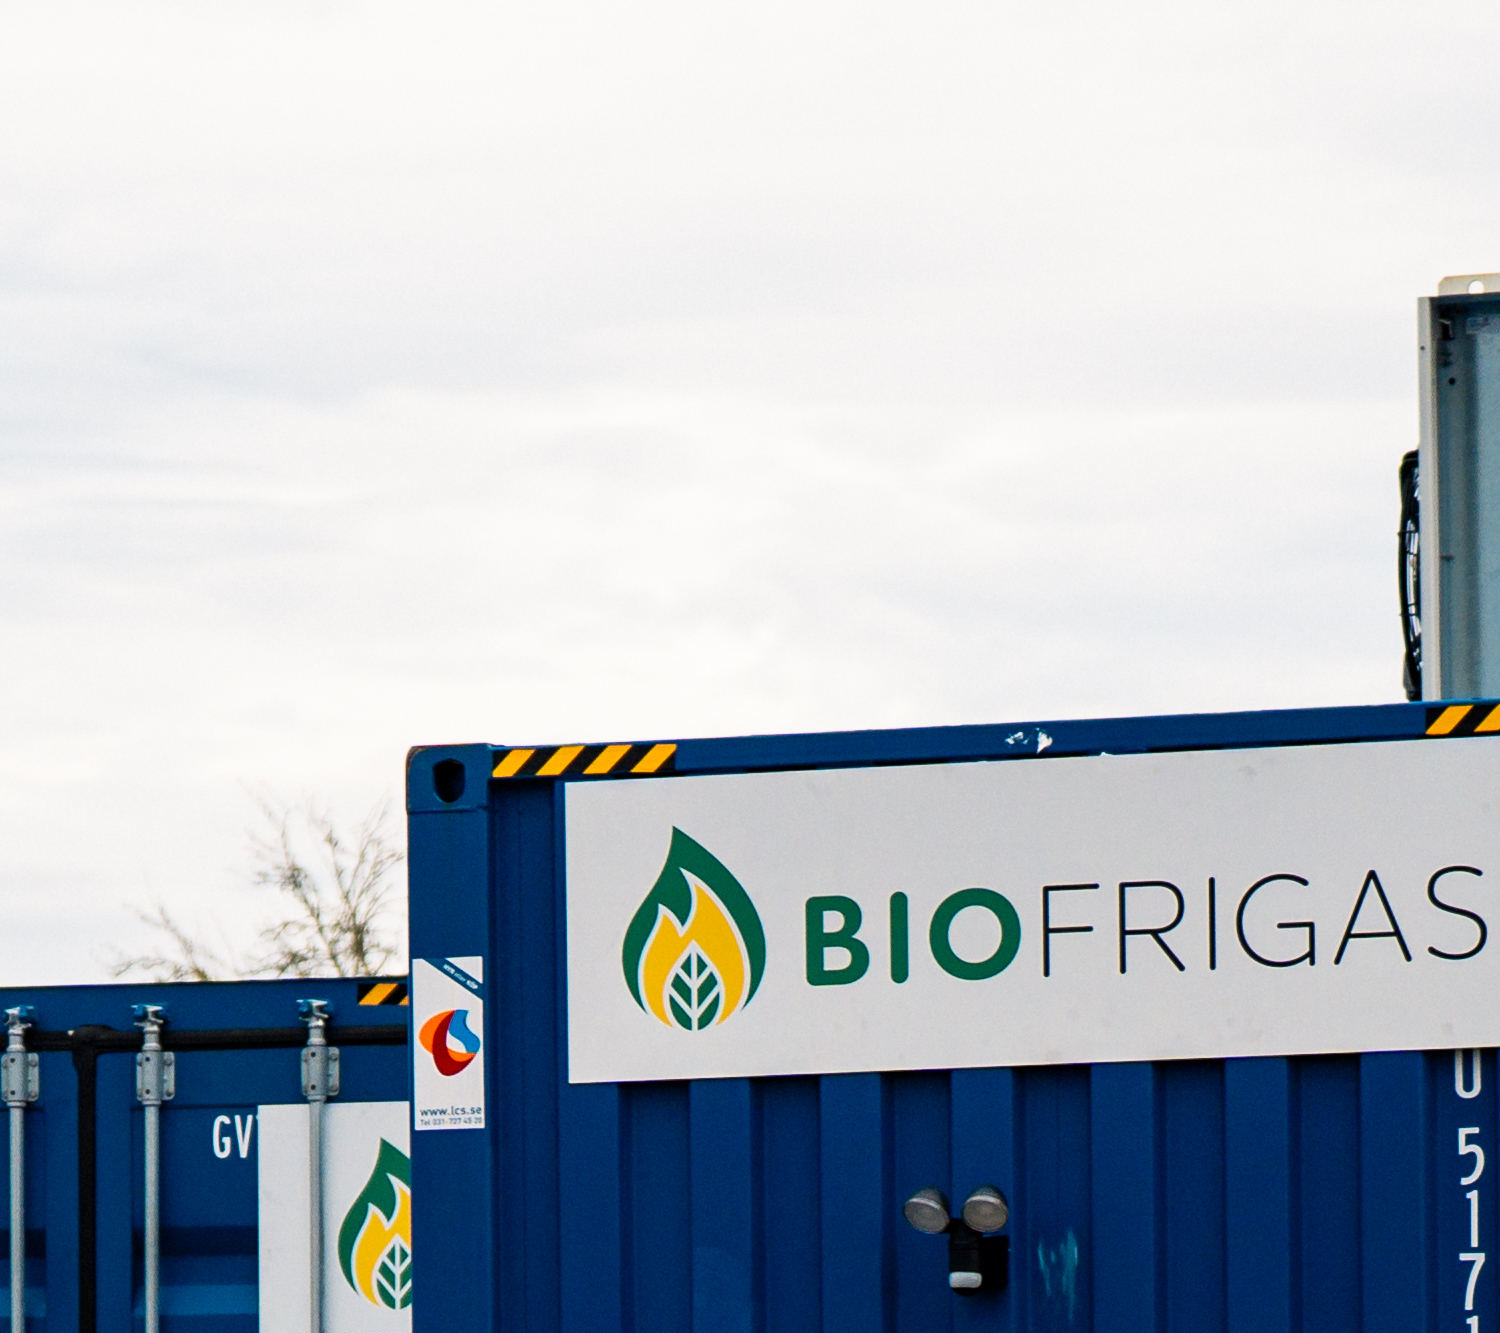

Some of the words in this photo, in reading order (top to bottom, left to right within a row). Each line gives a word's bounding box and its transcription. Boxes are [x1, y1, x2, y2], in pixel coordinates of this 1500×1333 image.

[805, 865, 1489, 986] BIOFRIGAS
[420, 1105, 482, 1117] www.lcs.se
[212, 1115, 258, 1159] GV
